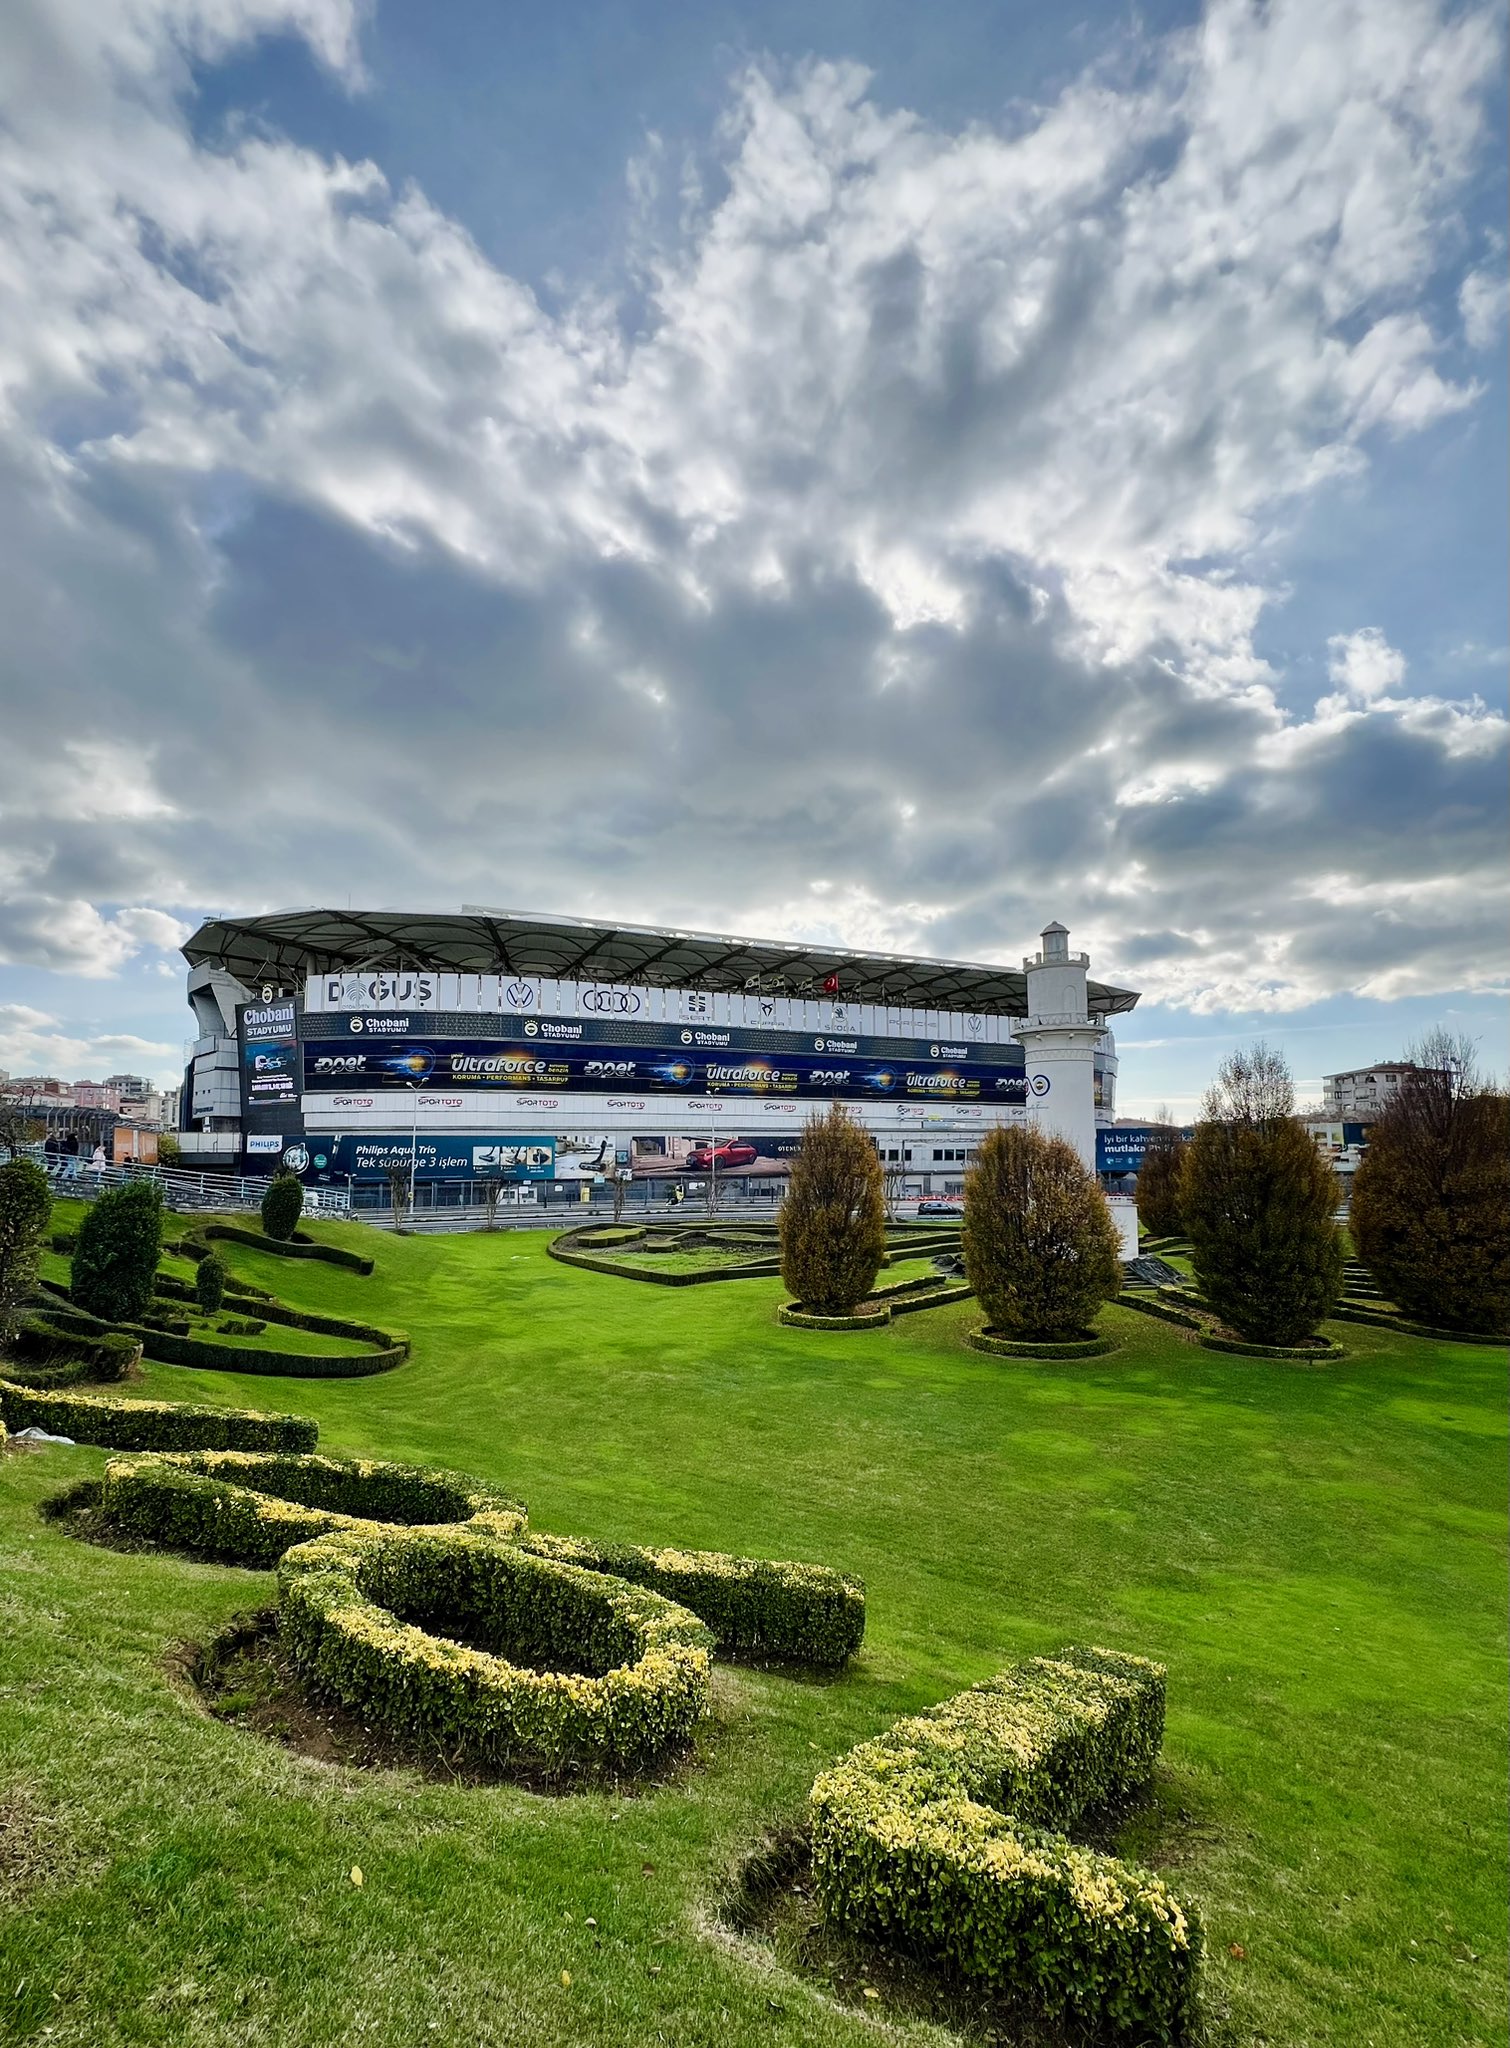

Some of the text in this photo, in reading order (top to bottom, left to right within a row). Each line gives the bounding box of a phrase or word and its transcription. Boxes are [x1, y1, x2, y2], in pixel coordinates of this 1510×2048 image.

[243, 1003, 295, 1025] Chobani
[366, 1018, 410, 1028] Chobani
[541, 1022, 583, 1034] Chobani
[247, 1023, 292, 1036] STADYUMU
[695, 1031, 730, 1042] Chobani
[826, 1040, 858, 1050] Chobani
[940, 1046, 968, 1056] Chobani
[314, 1055, 367, 1075] opet
[583, 1061, 636, 1079] opet
[1116, 1134, 1128, 1143] bir
[250, 1141, 280, 1149] PHILIPS
[356, 1145, 437, 1156] Philips Aqua Trio
[1104, 1144, 1146, 1153] mutlaka
[356, 1157, 376, 1168] Tek
[378, 1157, 427, 1170] süpürge
[428, 1157, 436, 1168] 3
[438, 1156, 468, 1170] işlem
